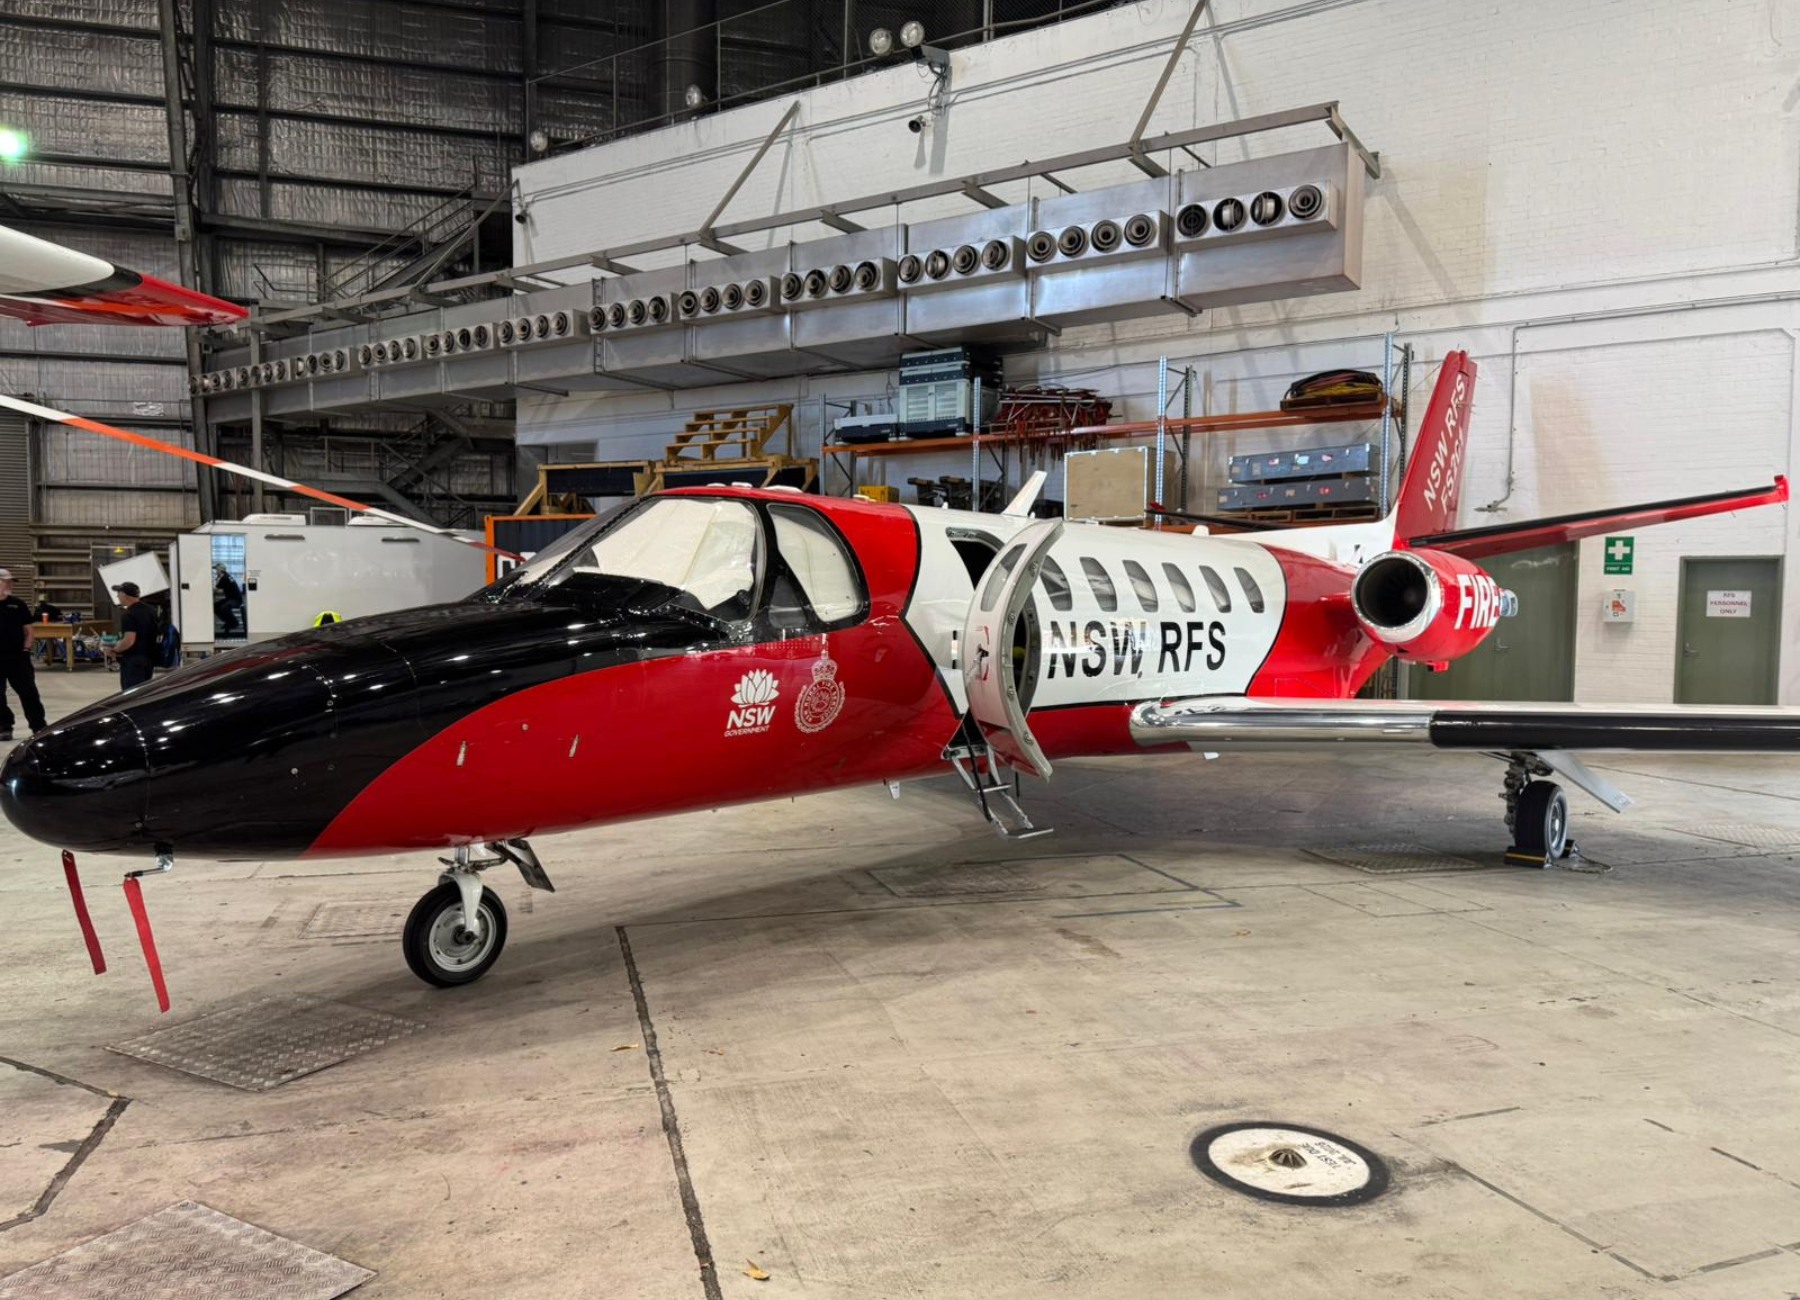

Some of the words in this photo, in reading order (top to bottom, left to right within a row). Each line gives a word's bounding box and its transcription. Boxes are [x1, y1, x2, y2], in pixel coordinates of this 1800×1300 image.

[1424, 430, 1449, 511] NSW
[1445, 374, 1466, 438] RFS
[1454, 573, 1501, 630] FIRE
[1047, 620, 1147, 679] NSW
[1158, 620, 1226, 674] RFS
[724, 724, 771, 738] GOVERNMENT
[726, 705, 776, 730] NSW
